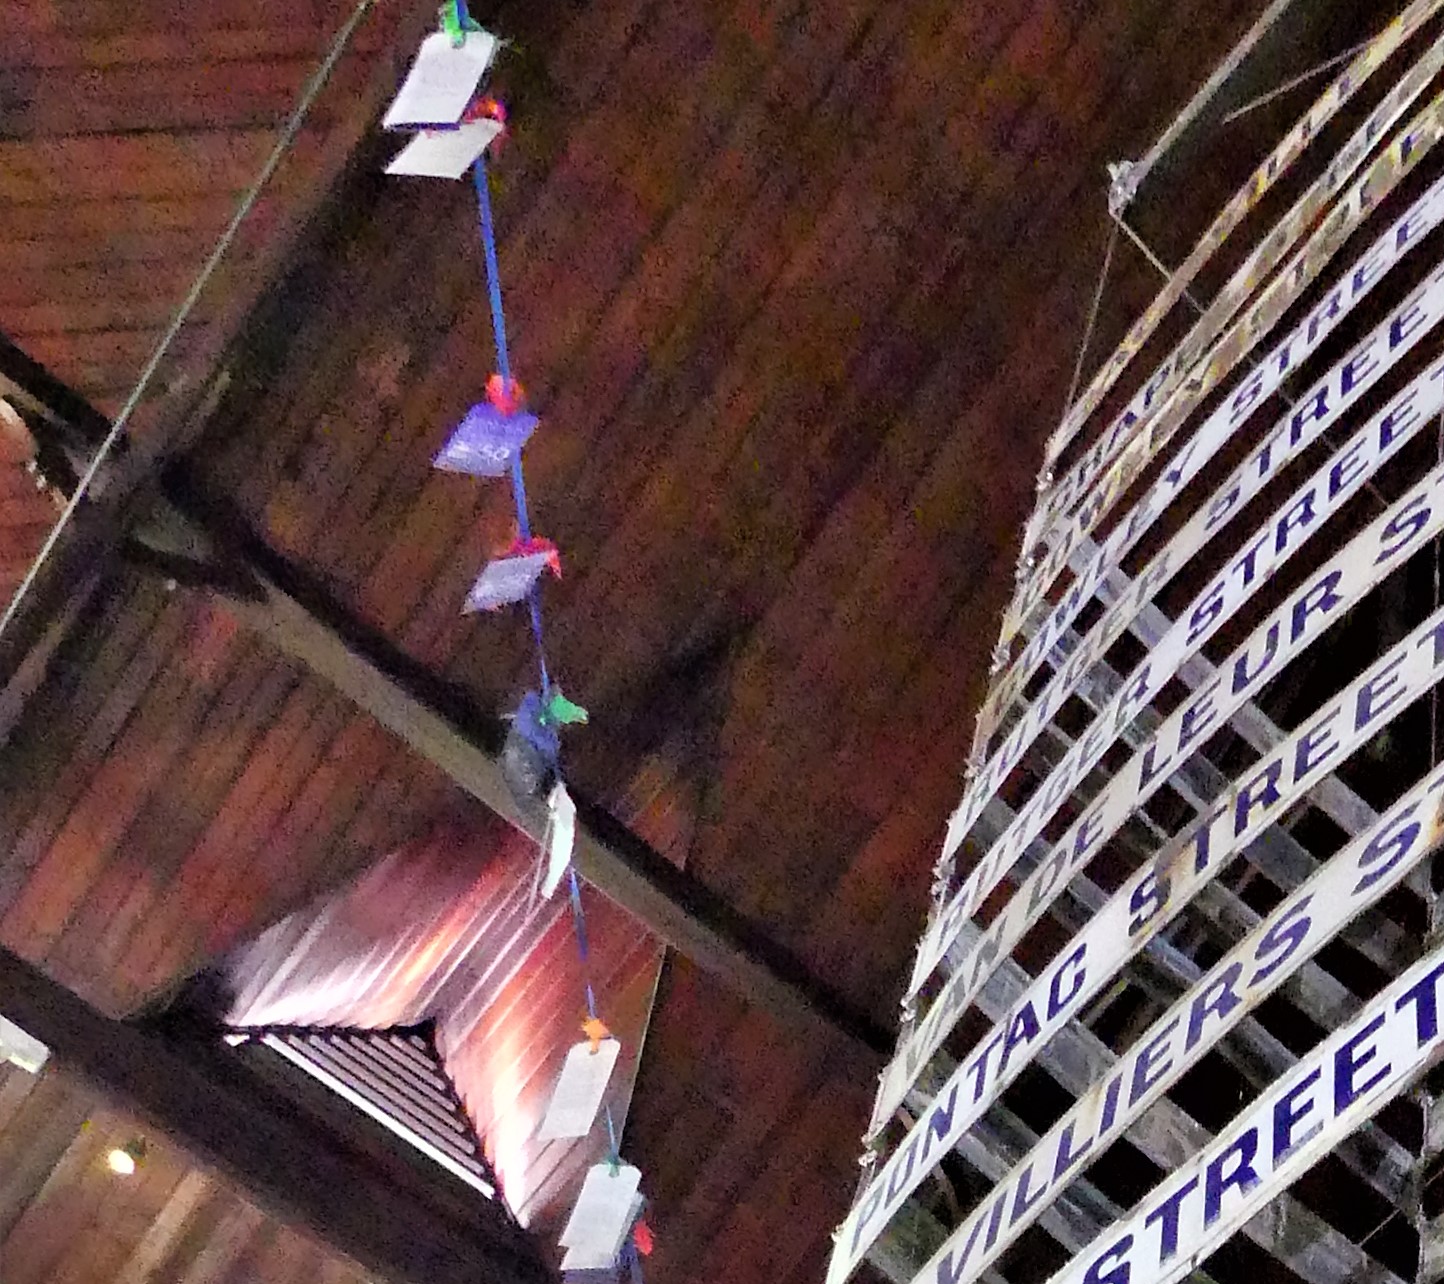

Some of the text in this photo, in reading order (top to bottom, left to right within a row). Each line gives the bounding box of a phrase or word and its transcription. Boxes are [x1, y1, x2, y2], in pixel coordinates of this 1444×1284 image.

[1012, 446, 1200, 690] OWLEY
[938, 662, 1154, 950] RUTGER
[1025, 793, 1110, 920] DE
[1139, 569, 1344, 792] LEUR
[850, 941, 1088, 1257] PONTAC
